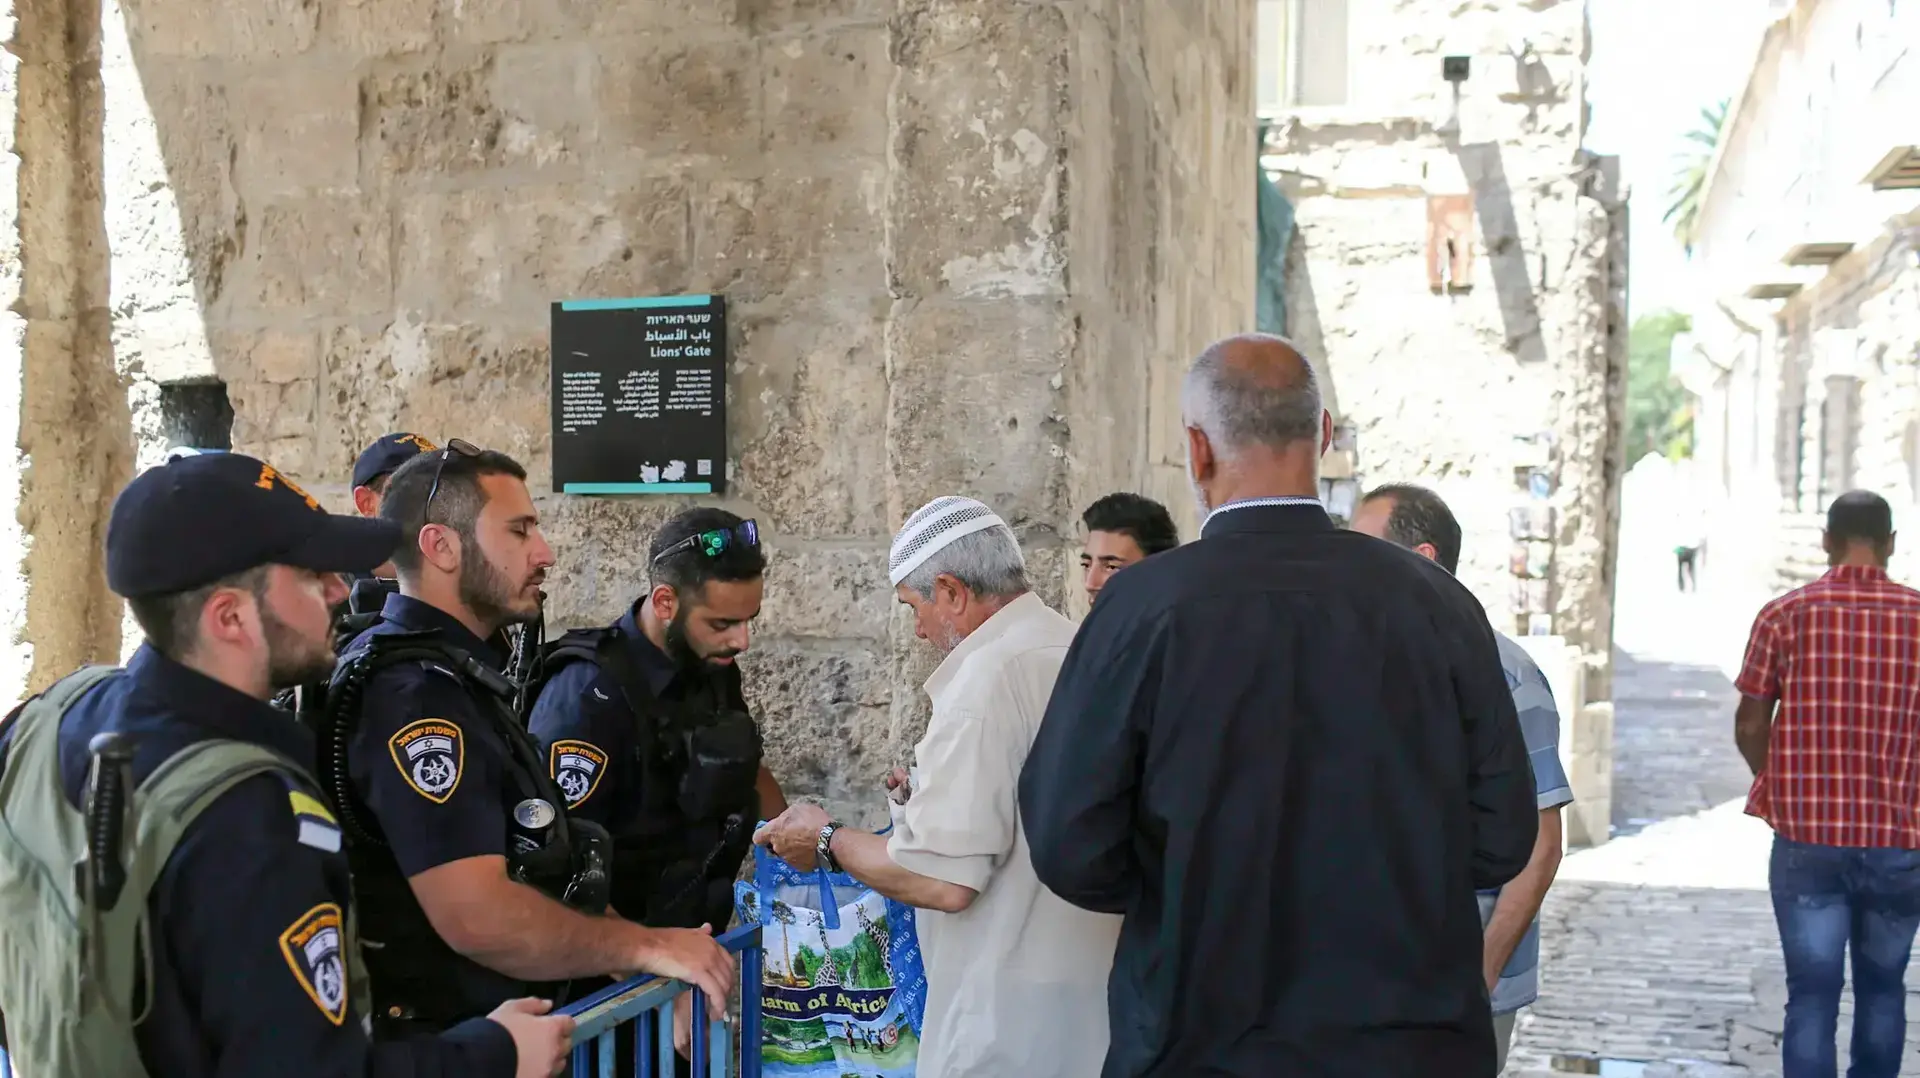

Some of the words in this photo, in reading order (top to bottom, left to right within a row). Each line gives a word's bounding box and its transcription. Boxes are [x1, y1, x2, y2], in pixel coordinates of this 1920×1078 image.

[646, 314, 685, 325] האריות
[686, 313, 711, 324] שער
[644, 328, 687, 344] الأسباط
[690, 328, 711, 343] باب
[650, 346, 682, 357] Lions'
[684, 345, 711, 356] Gate
[893, 931, 910, 952] ORLD
[904, 948, 916, 964] SEE
[807, 993, 829, 1010] of
[904, 991, 916, 1005] SEE
